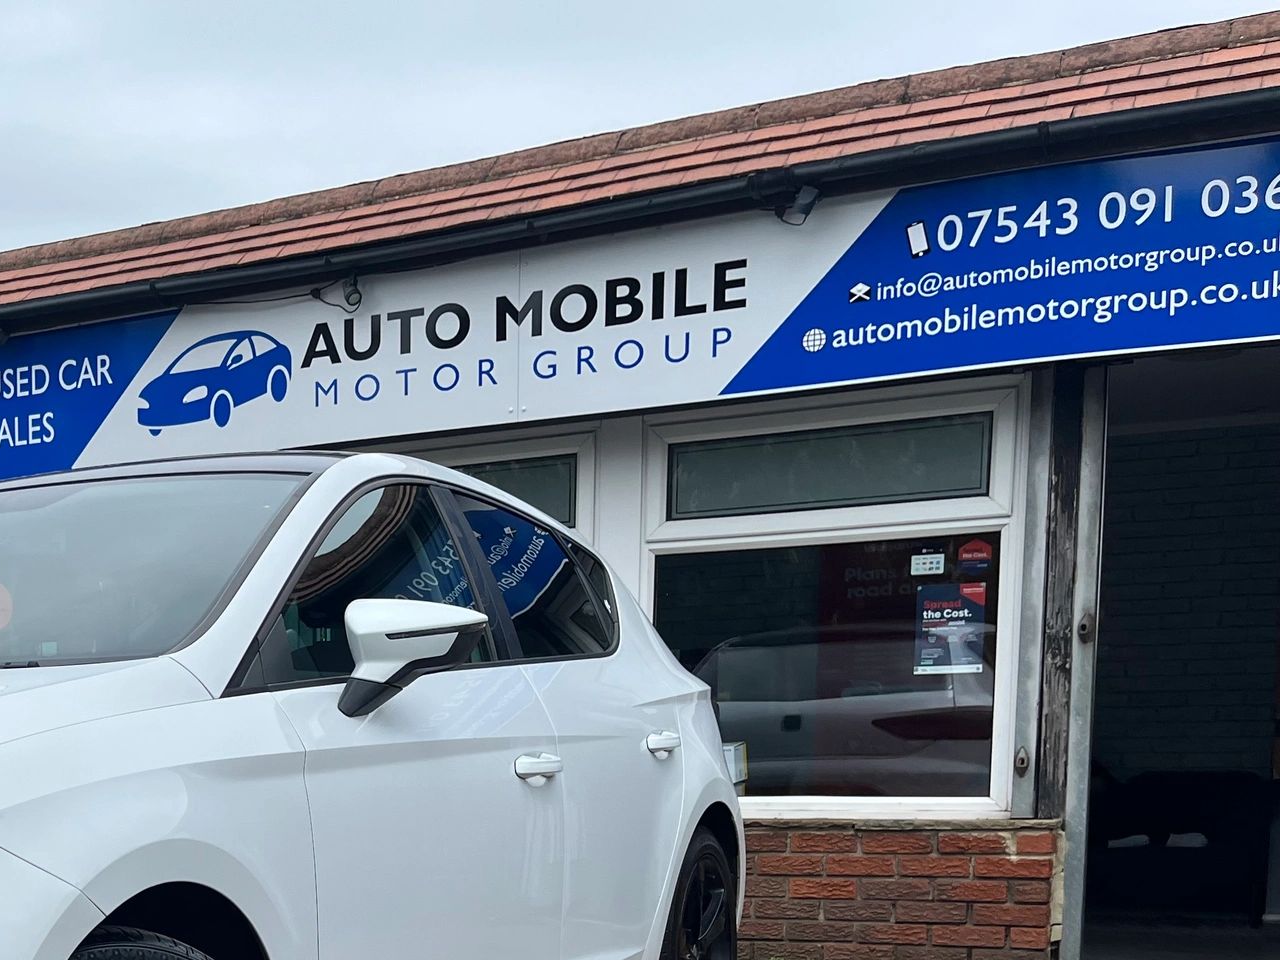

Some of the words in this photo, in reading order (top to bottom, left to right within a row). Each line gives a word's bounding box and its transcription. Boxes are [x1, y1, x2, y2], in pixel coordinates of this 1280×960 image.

[937, 197, 1079, 252] 07543
[1099, 185, 1173, 231] 091
[1201, 174, 1280, 219] 036
[877, 232, 1280, 301] info@automobilemotorgroup.co.u
[301, 302, 470, 368] AUTO
[495, 259, 748, 343] MOBILE
[833, 270, 1280, 347] automobilemotorgroup.co.uk
[59, 355, 113, 390] CAR
[315, 351, 498, 406] MOTOR
[533, 328, 732, 378] GROUP
[922, 610, 942, 619] the
[943, 608, 973, 618] Cost.
[923, 600, 962, 610] Spread
